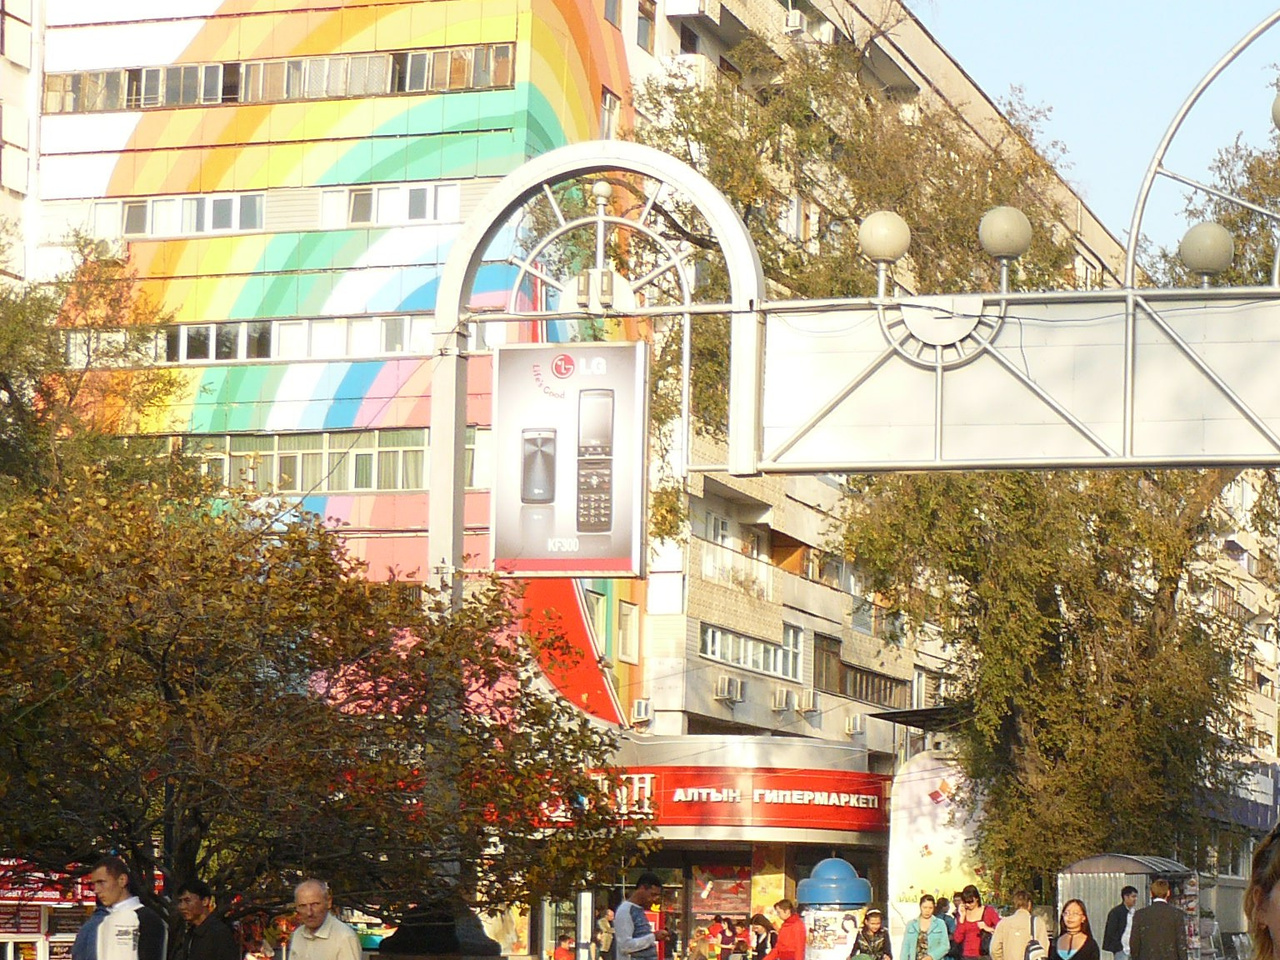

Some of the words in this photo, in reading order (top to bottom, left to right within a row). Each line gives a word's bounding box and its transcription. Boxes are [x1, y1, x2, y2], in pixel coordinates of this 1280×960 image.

[580, 357, 607, 375] LG
[543, 386, 565, 399] Good
[547, 538, 579, 552] KF300
[673, 788, 741, 803] АЛТЫН
[753, 789, 879, 809] ГИПЕРМАРКЕТІ
